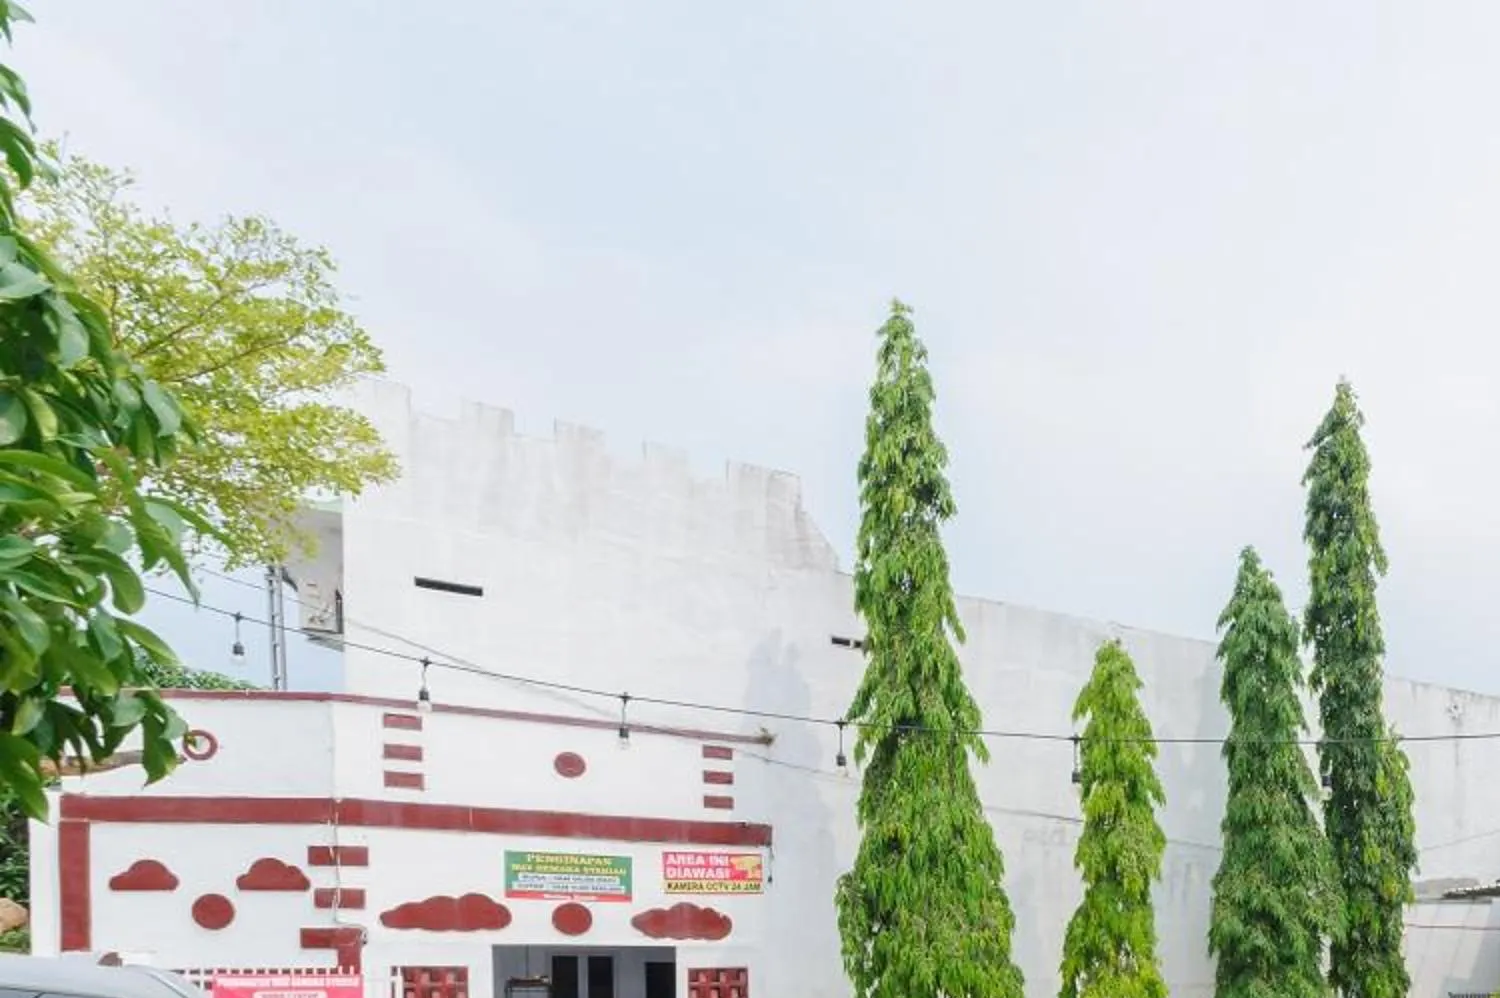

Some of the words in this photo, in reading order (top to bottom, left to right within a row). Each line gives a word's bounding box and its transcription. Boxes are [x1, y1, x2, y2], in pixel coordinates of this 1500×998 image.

[666, 853, 705, 866] AREA
[709, 854, 729, 867] INI
[666, 866, 730, 879] DIAWASI
[667, 881, 703, 891] KAMERA
